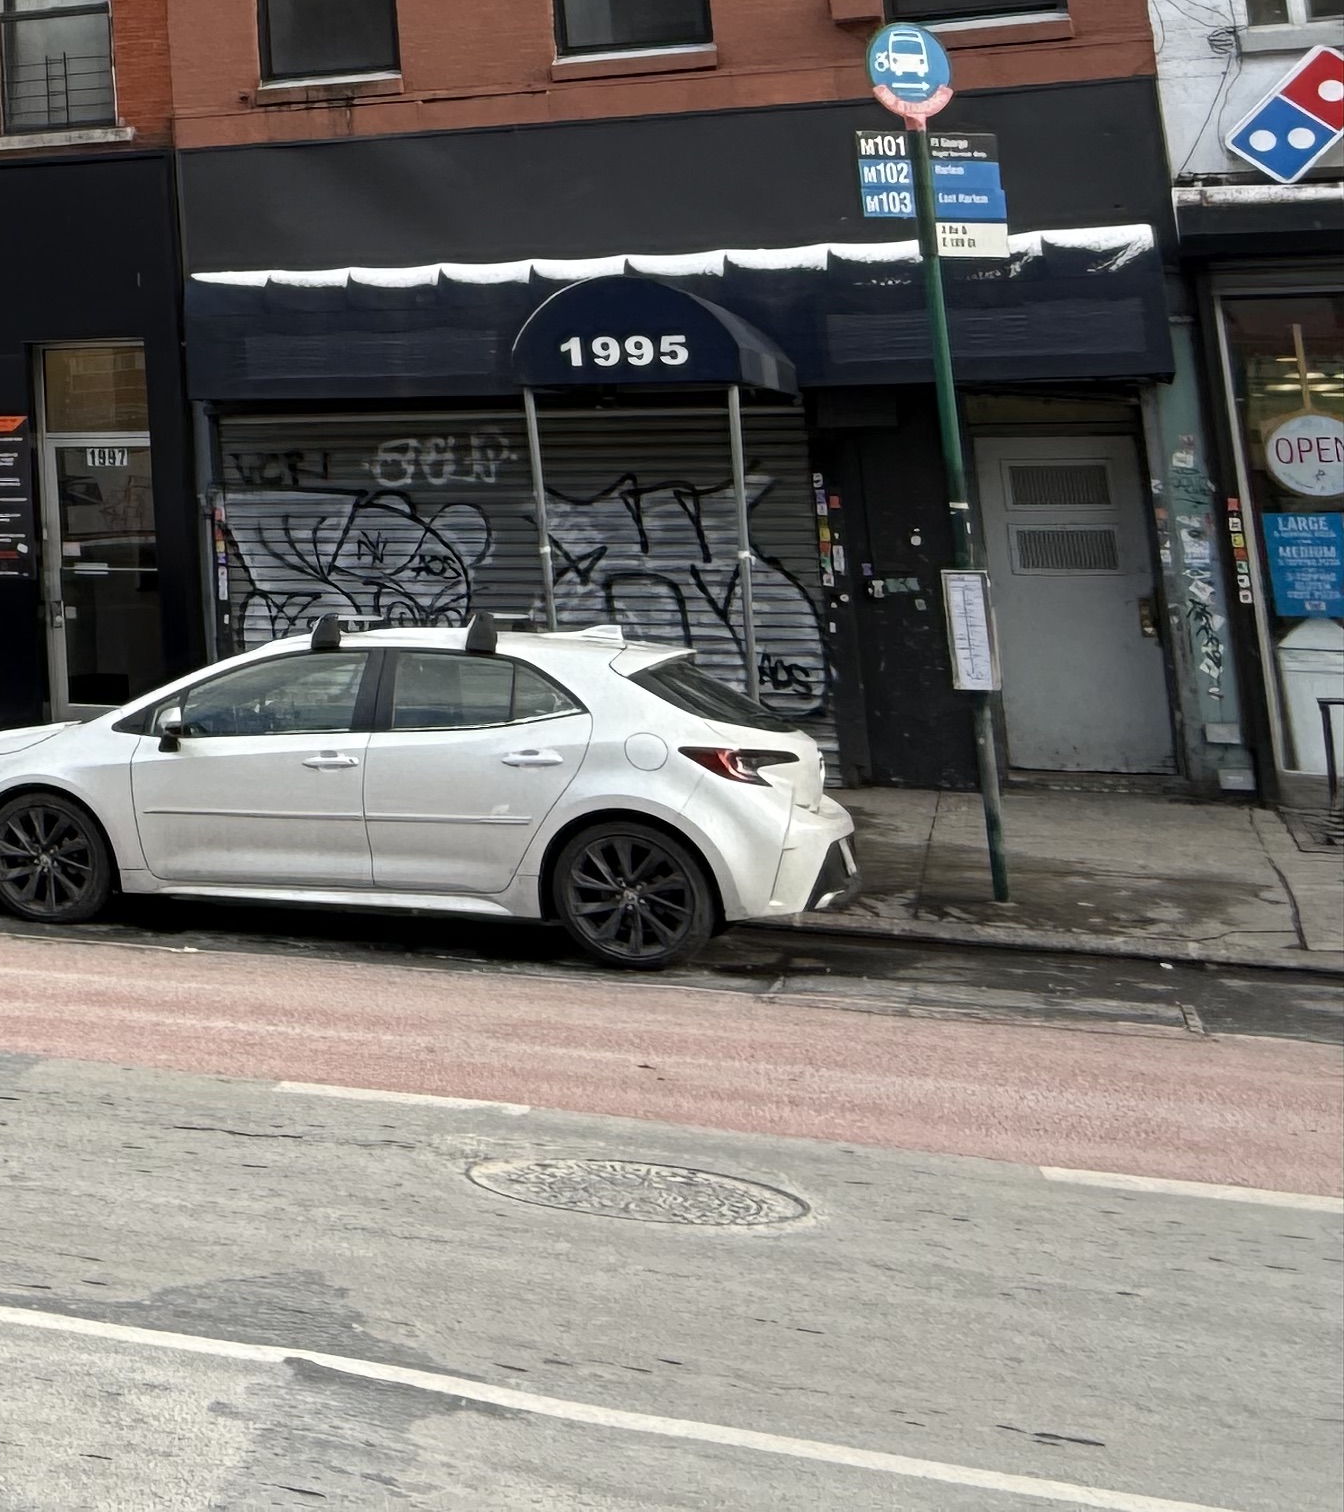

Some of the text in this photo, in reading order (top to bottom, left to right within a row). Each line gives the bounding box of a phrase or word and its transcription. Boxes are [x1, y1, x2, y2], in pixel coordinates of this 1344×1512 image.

[860, 135, 906, 157] M101
[863, 162, 909, 184] M102
[865, 191, 912, 213] M103
[560, 335, 689, 367] 1995
[87, 448, 127, 467] 1997
[1277, 516, 1329, 531] LARGE
